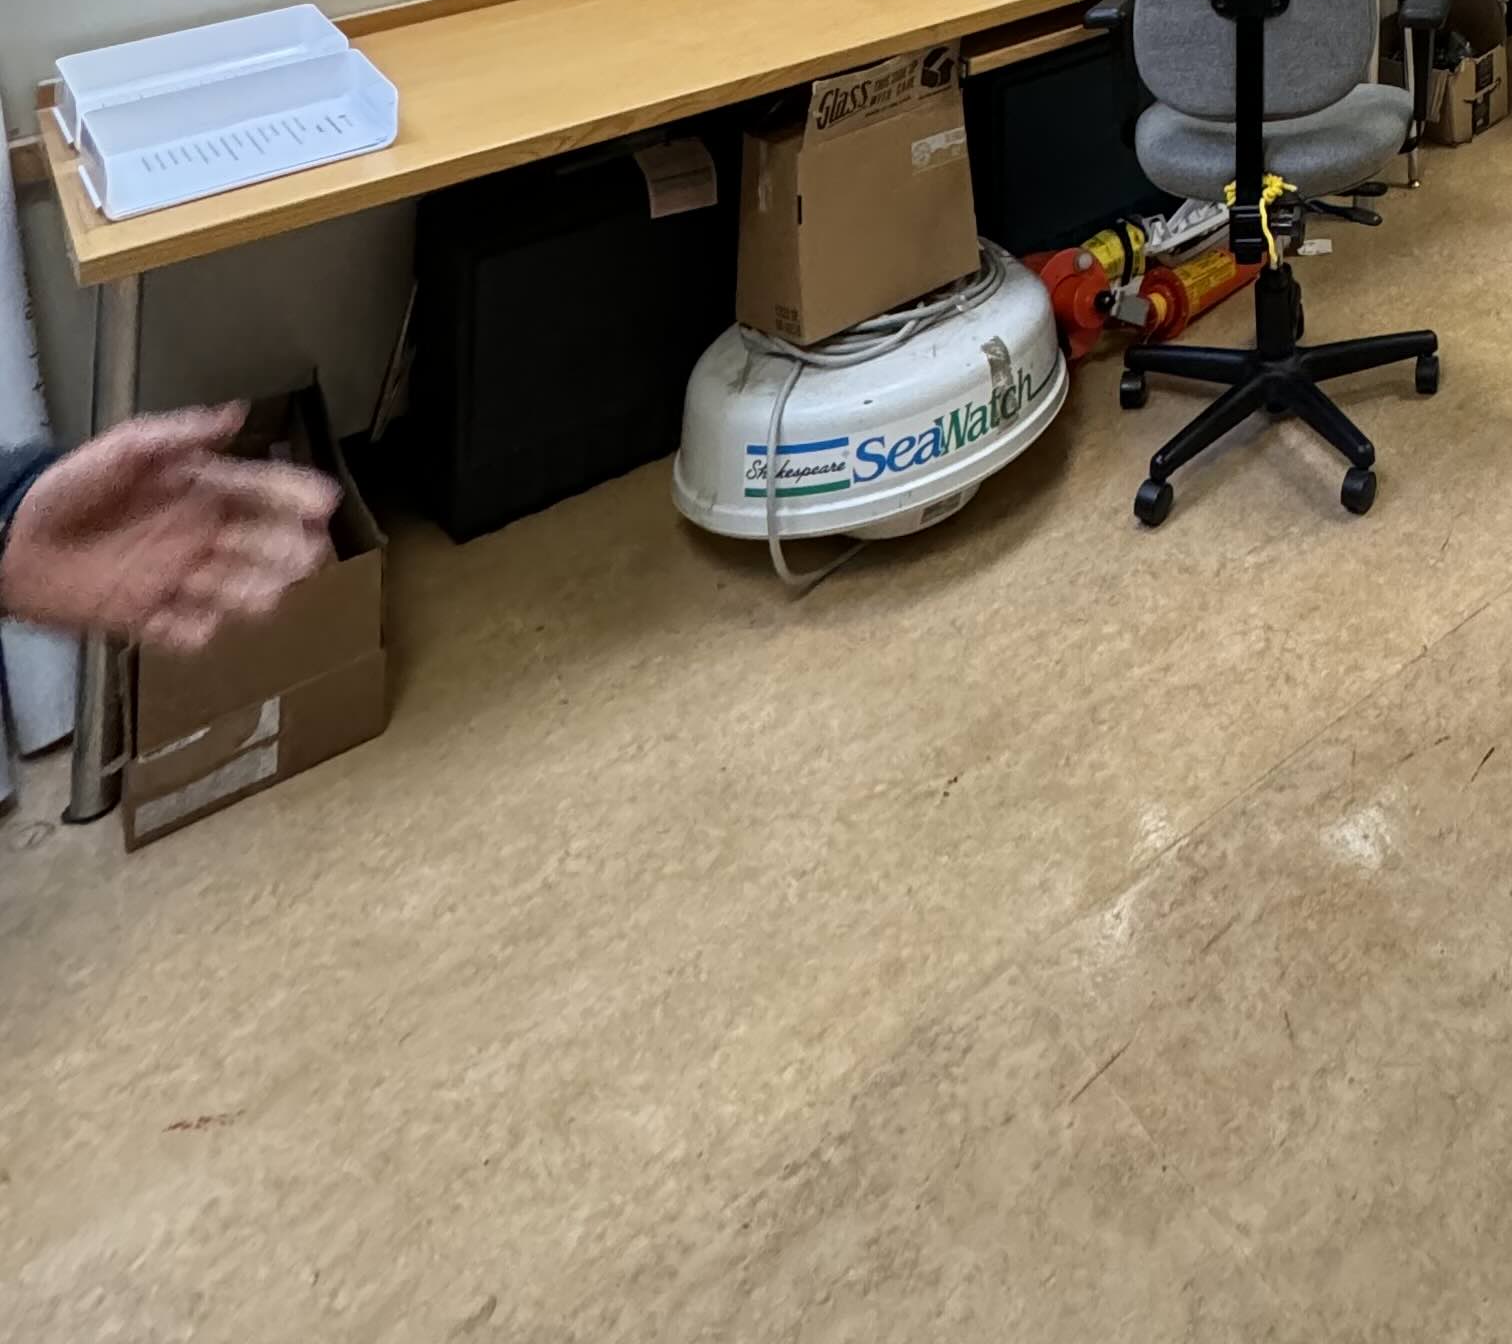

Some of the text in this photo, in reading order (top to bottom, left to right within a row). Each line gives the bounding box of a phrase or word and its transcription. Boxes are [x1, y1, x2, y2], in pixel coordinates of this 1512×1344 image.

[815, 79, 872, 131] Glass
[852, 367, 1045, 485] SeaWatch
[745, 458, 847, 484] Shkespeare
